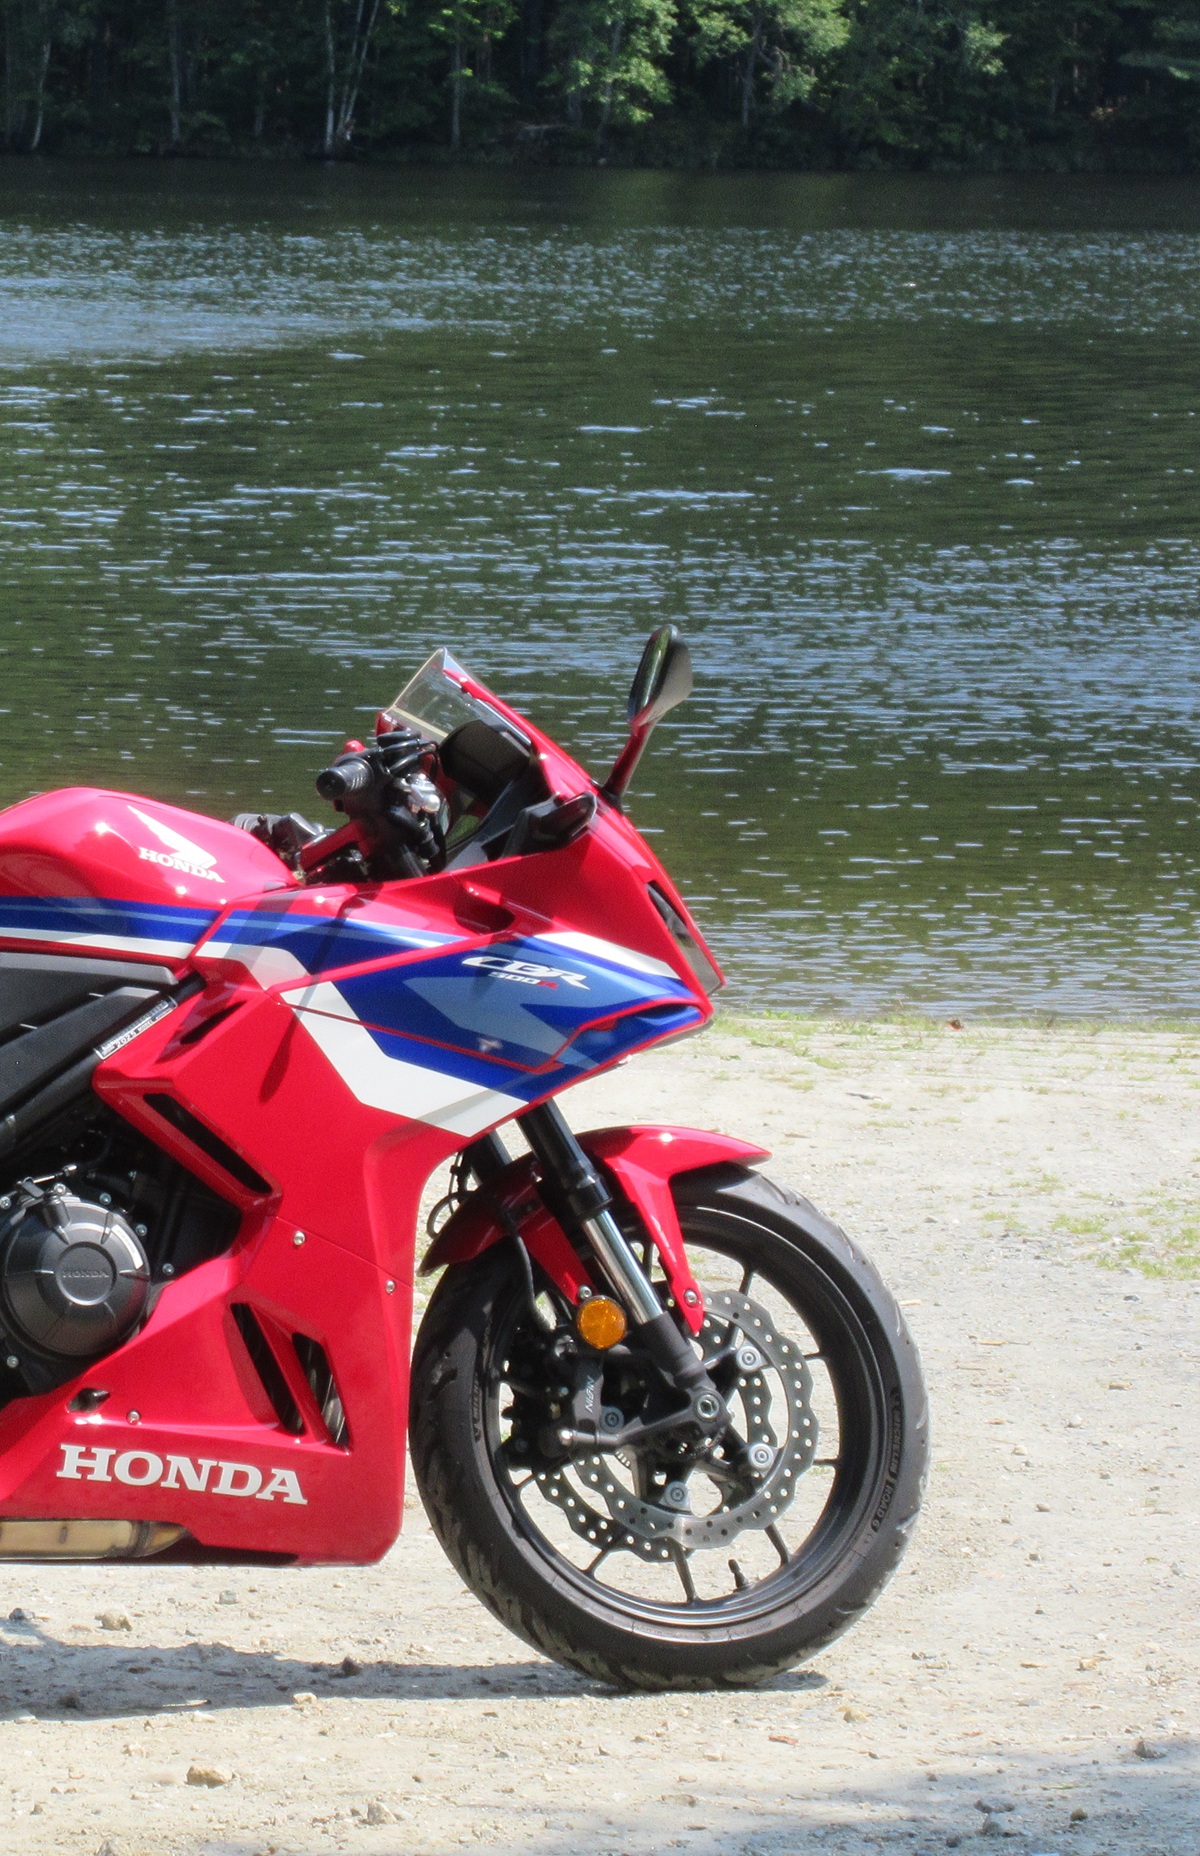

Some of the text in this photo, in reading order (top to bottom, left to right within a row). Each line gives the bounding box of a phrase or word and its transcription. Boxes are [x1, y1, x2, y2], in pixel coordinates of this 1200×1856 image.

[138, 846, 226, 883] HONDA
[461, 955, 591, 990] CBR
[487, 971, 558, 989] 500R
[61, 1269, 110, 1279] HONDA
[56, 1444, 308, 1505] HONDA
[876, 1484, 895, 1518] ROAD
